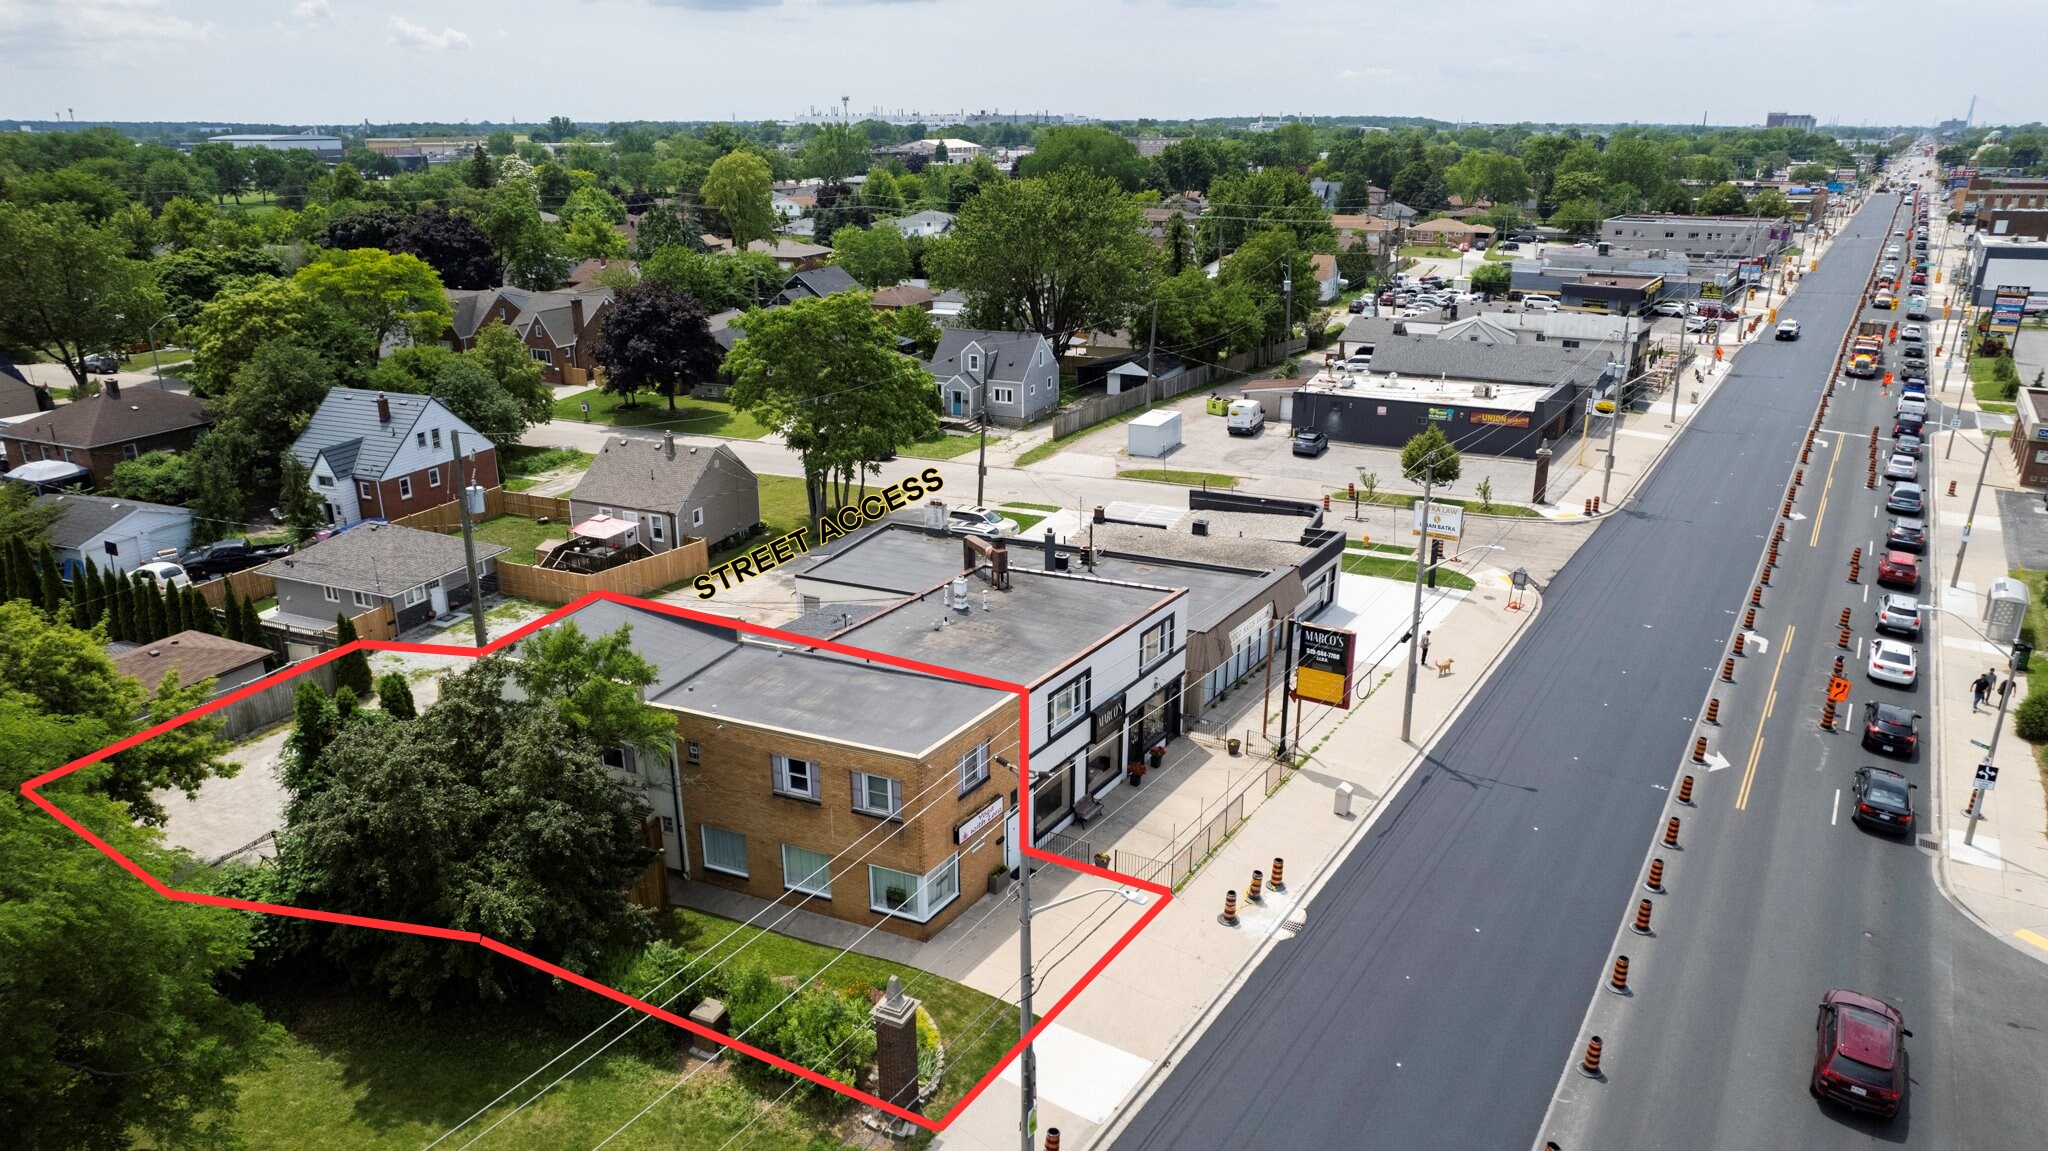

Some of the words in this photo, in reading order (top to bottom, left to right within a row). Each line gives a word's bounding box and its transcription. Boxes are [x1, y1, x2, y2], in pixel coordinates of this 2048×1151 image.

[1481, 413, 1507, 423] UNION
[1442, 507, 1457, 515] LAW
[1437, 524, 1456, 532] BATRA
[1305, 630, 1344, 648] MARCO'S
[1098, 702, 1123, 727] MARCO'S
